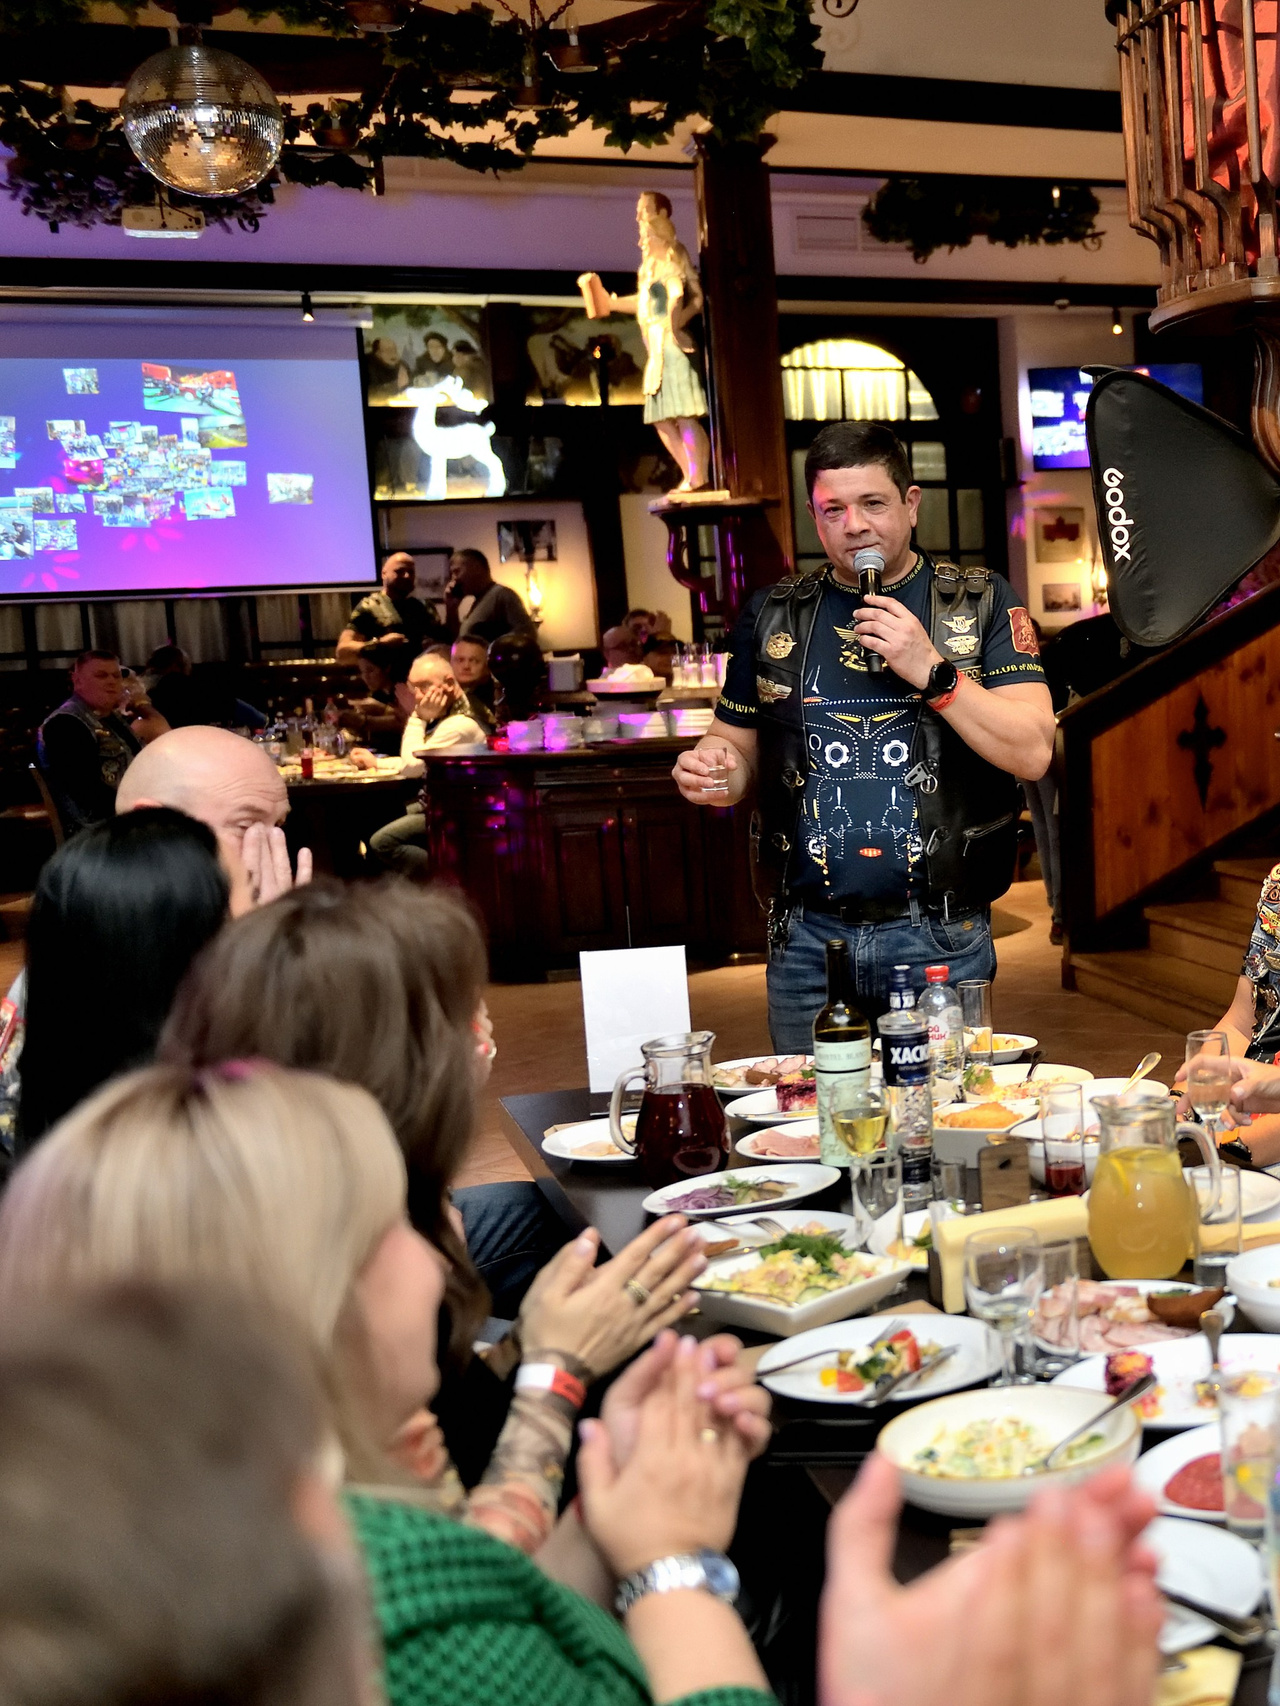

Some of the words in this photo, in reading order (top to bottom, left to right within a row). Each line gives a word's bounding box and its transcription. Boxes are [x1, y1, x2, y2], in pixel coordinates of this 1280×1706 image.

[1102, 467, 1134, 562] Godox
[735, 703, 759, 713] WIN
[890, 1043, 930, 1064] ХАСК
